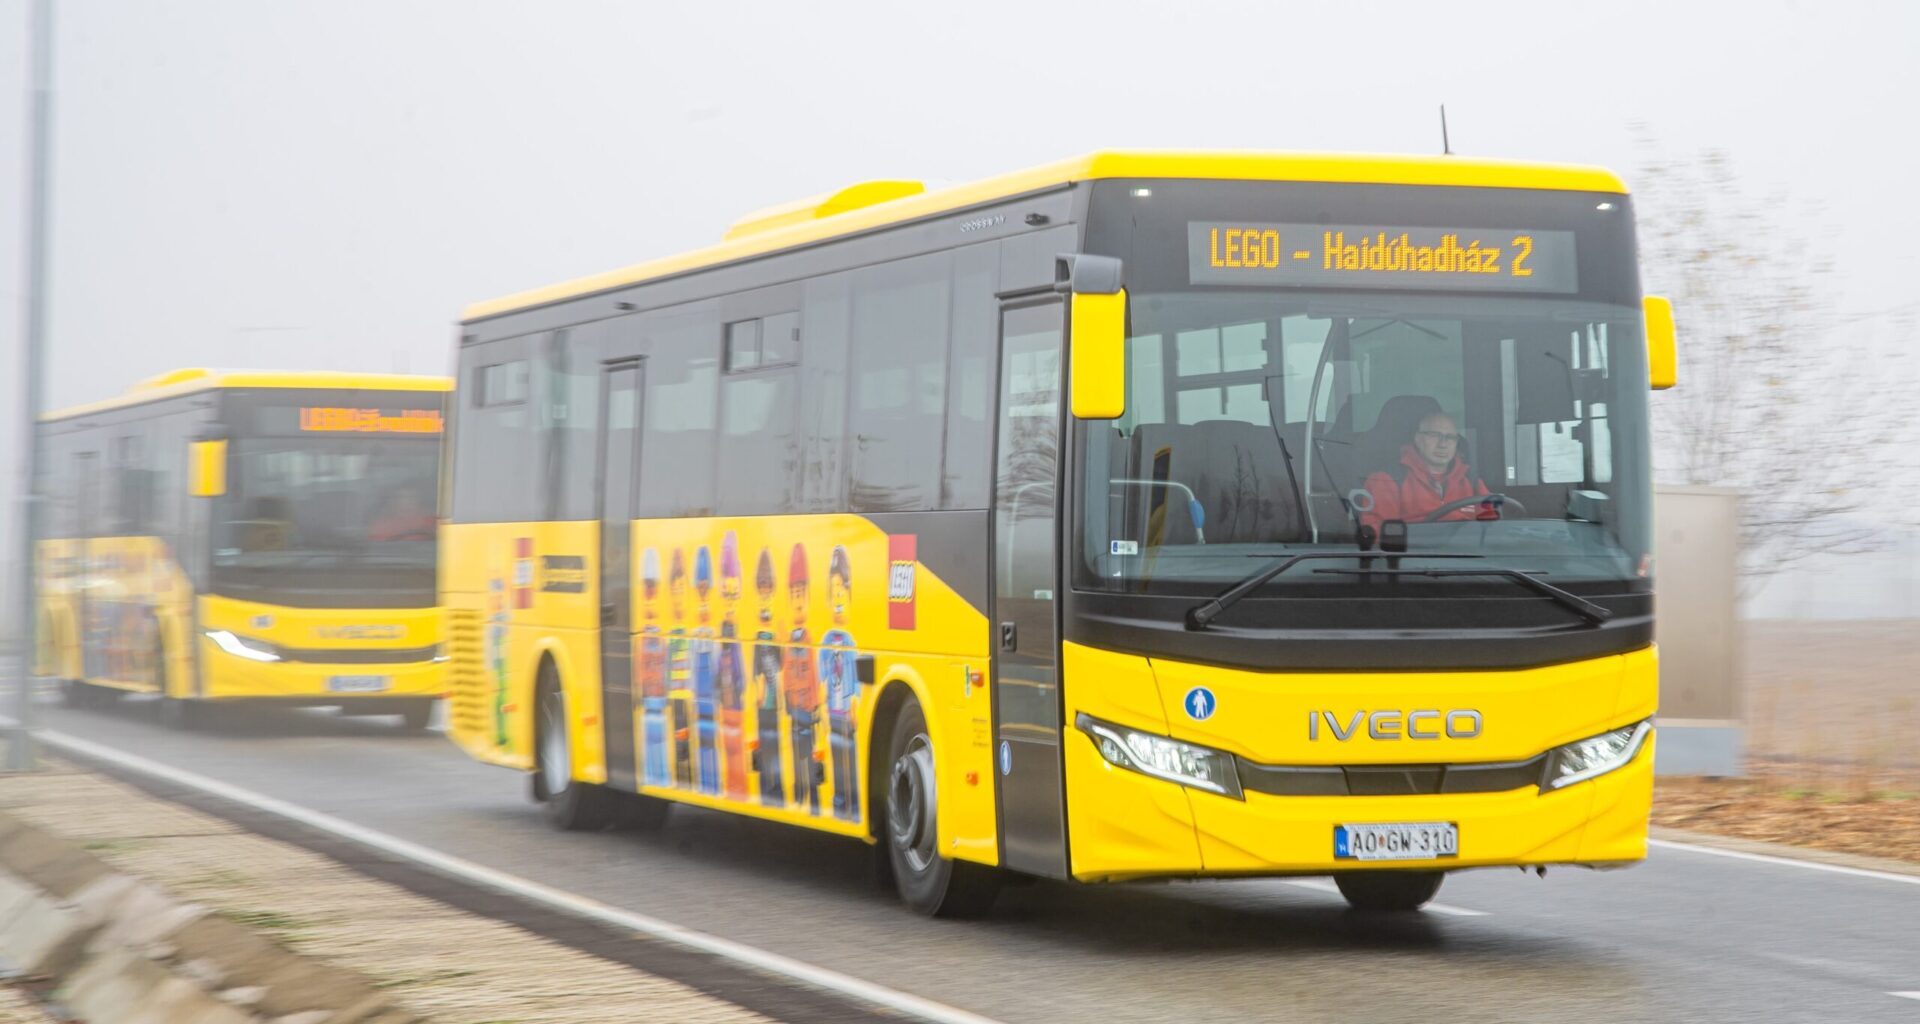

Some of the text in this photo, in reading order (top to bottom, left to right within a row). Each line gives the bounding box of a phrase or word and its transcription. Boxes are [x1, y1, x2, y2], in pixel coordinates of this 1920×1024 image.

[1211, 227, 1533, 276] LEGO - Hajdúhadház 2
[1309, 709, 1483, 741] IVECO
